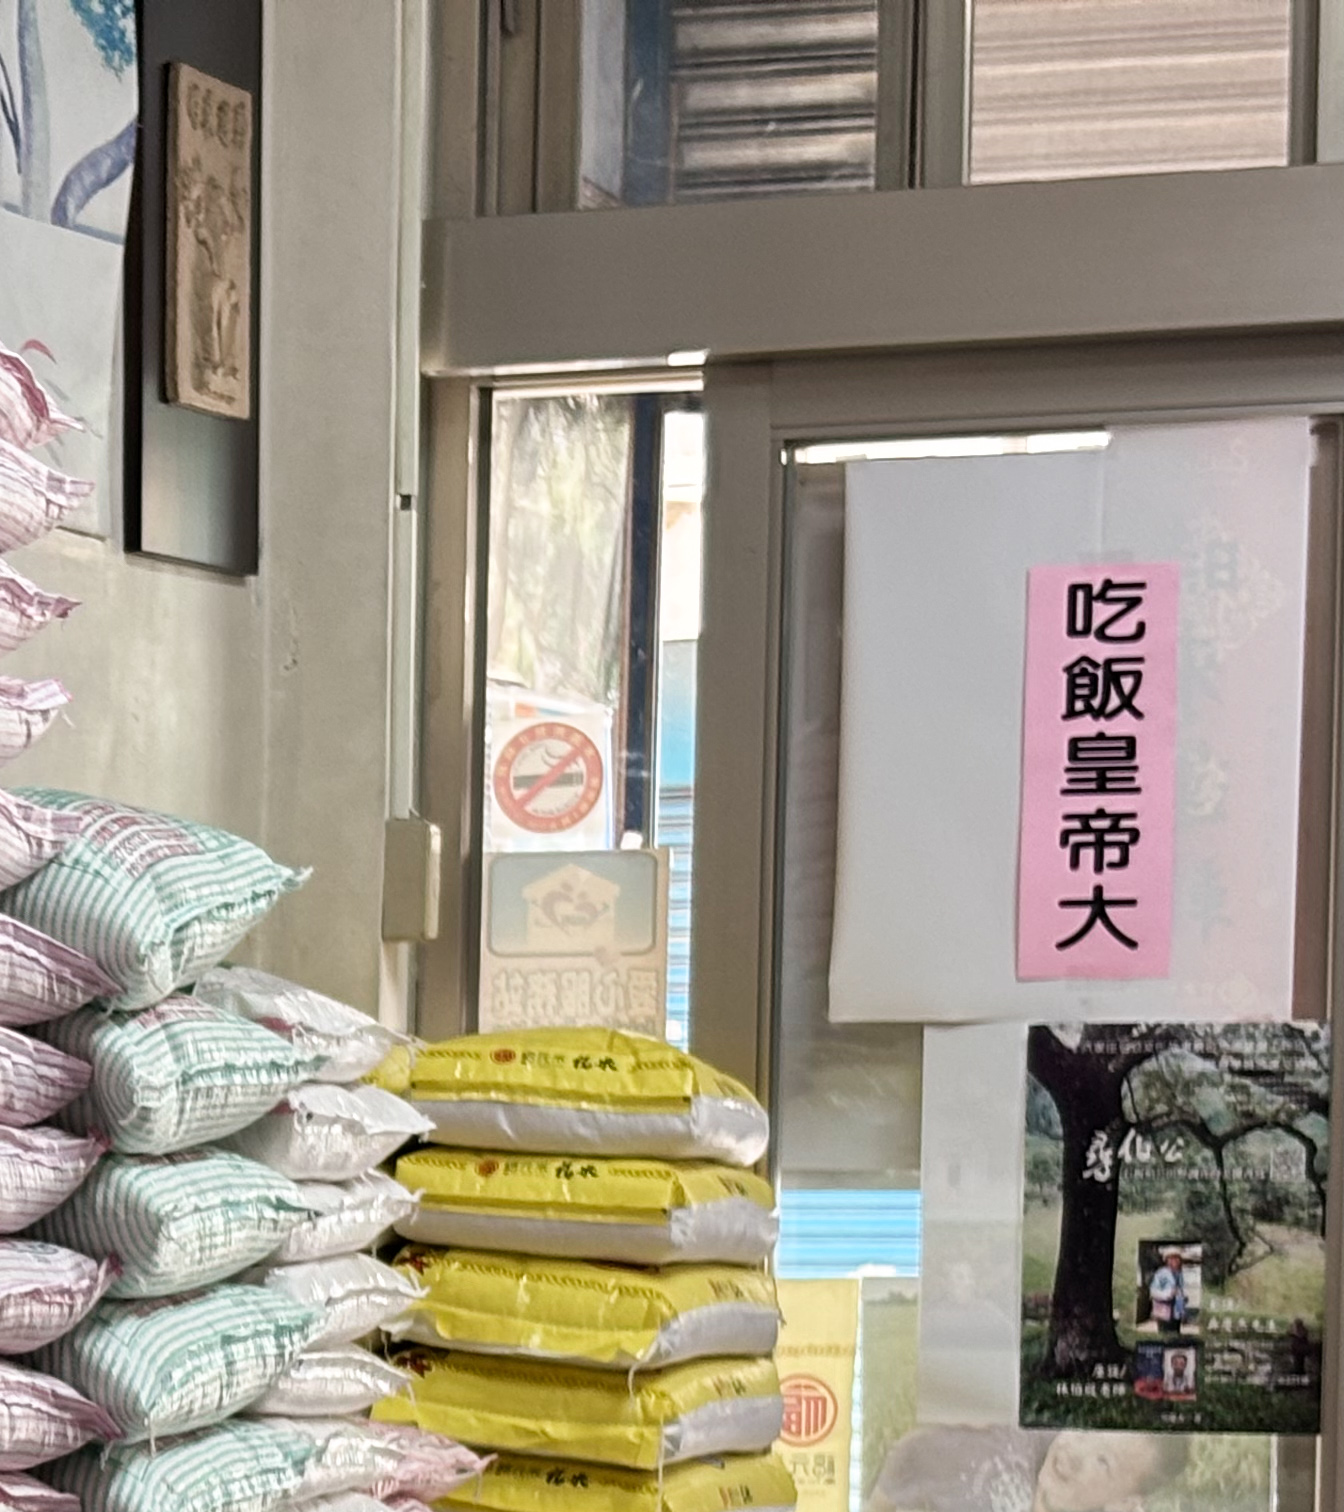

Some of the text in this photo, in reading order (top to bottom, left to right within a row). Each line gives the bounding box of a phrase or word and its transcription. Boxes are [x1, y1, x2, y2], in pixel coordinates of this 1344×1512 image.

[1055, 578, 1146, 952] 吃飯皇帝大
